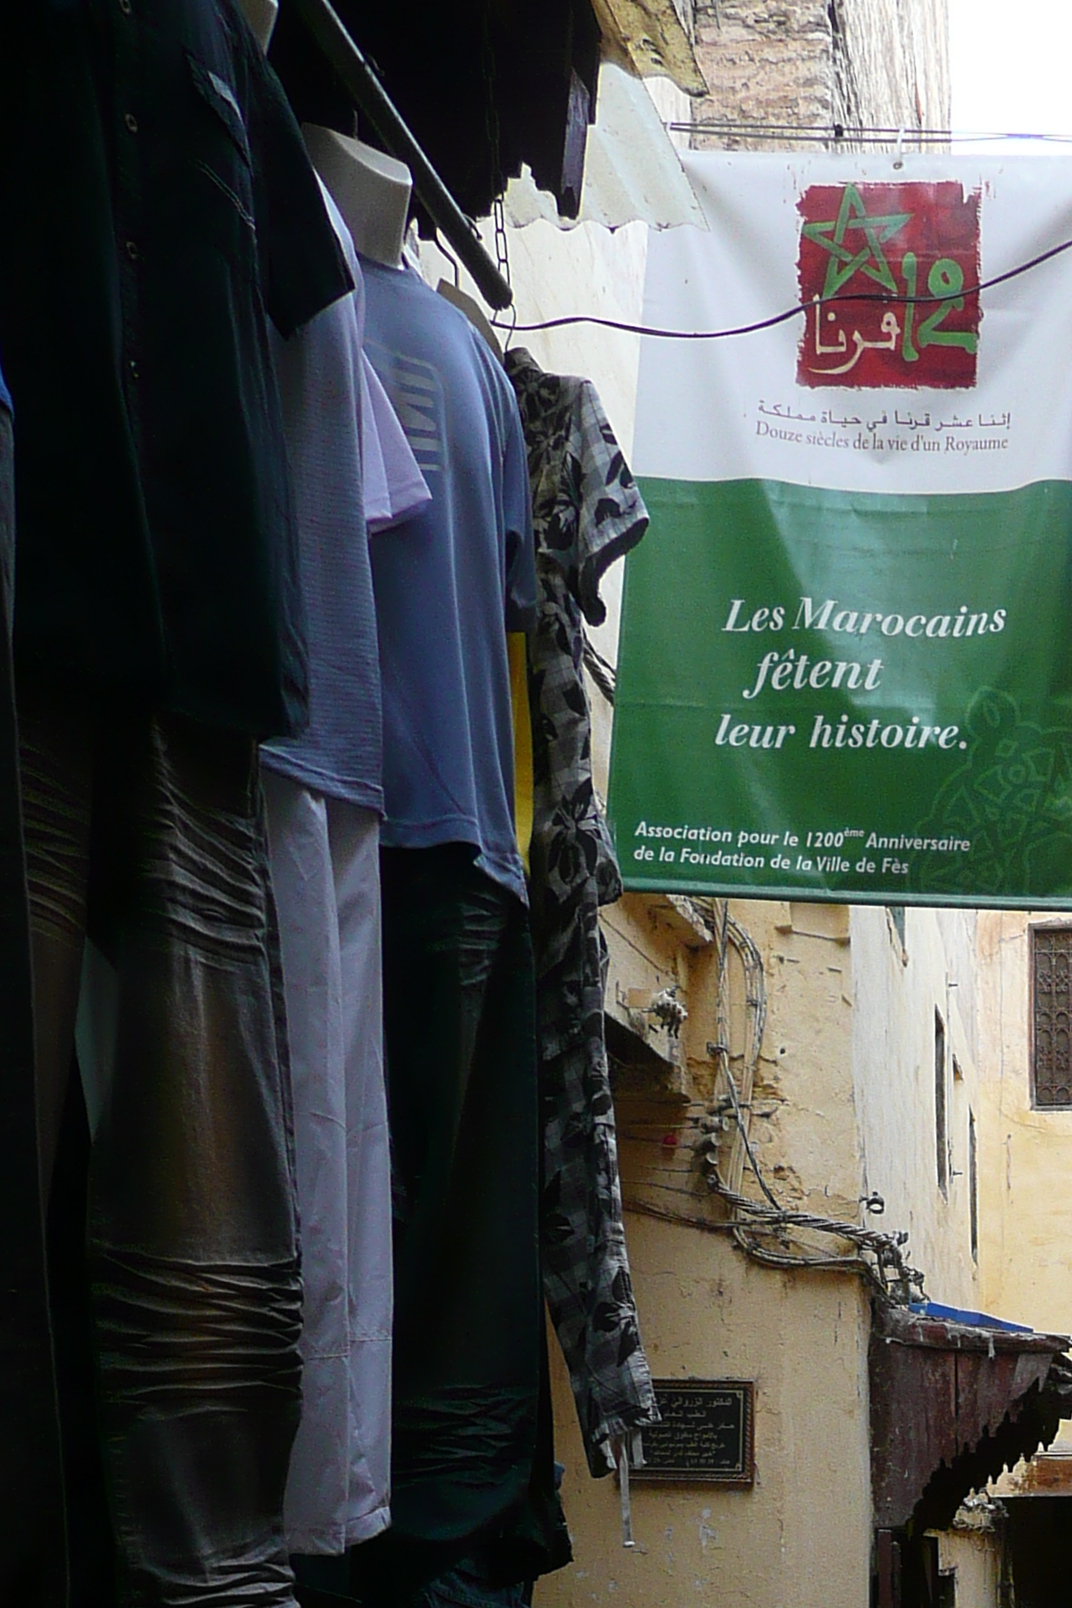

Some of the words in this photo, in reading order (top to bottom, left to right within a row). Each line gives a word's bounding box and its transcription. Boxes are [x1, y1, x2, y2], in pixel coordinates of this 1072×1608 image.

[758, 399, 816, 421] مملكة
[820, 409, 862, 428] حياة
[866, 410, 888, 432] في
[894, 410, 930, 430] قرنا
[935, 414, 973, 431] عشر
[756, 420, 802, 442] Douze
[806, 431, 849, 448] siècles
[853, 432, 870, 449] de
[872, 432, 884, 450] la
[887, 434, 907, 450] vie
[911, 434, 940, 451] d'un
[945, 436, 1009, 456] Royaume
[721, 599, 785, 633] Les
[791, 596, 1007, 638] Marocains
[742, 648, 885, 699] fêtent
[715, 714, 795, 748] leur
[809, 714, 967, 749] histoire.
[634, 820, 733, 843] Association
[737, 831, 779, 848] pour
[783, 831, 799, 847] le
[865, 832, 971, 851] Anniversaire
[633, 845, 655, 861] de
[659, 846, 675, 862] la
[680, 848, 765, 868] Fondation
[770, 854, 791, 869] de
[796, 855, 812, 871] la
[817, 856, 850, 872] Ville
[855, 857, 876, 873] de
[881, 857, 909, 874] Fès
